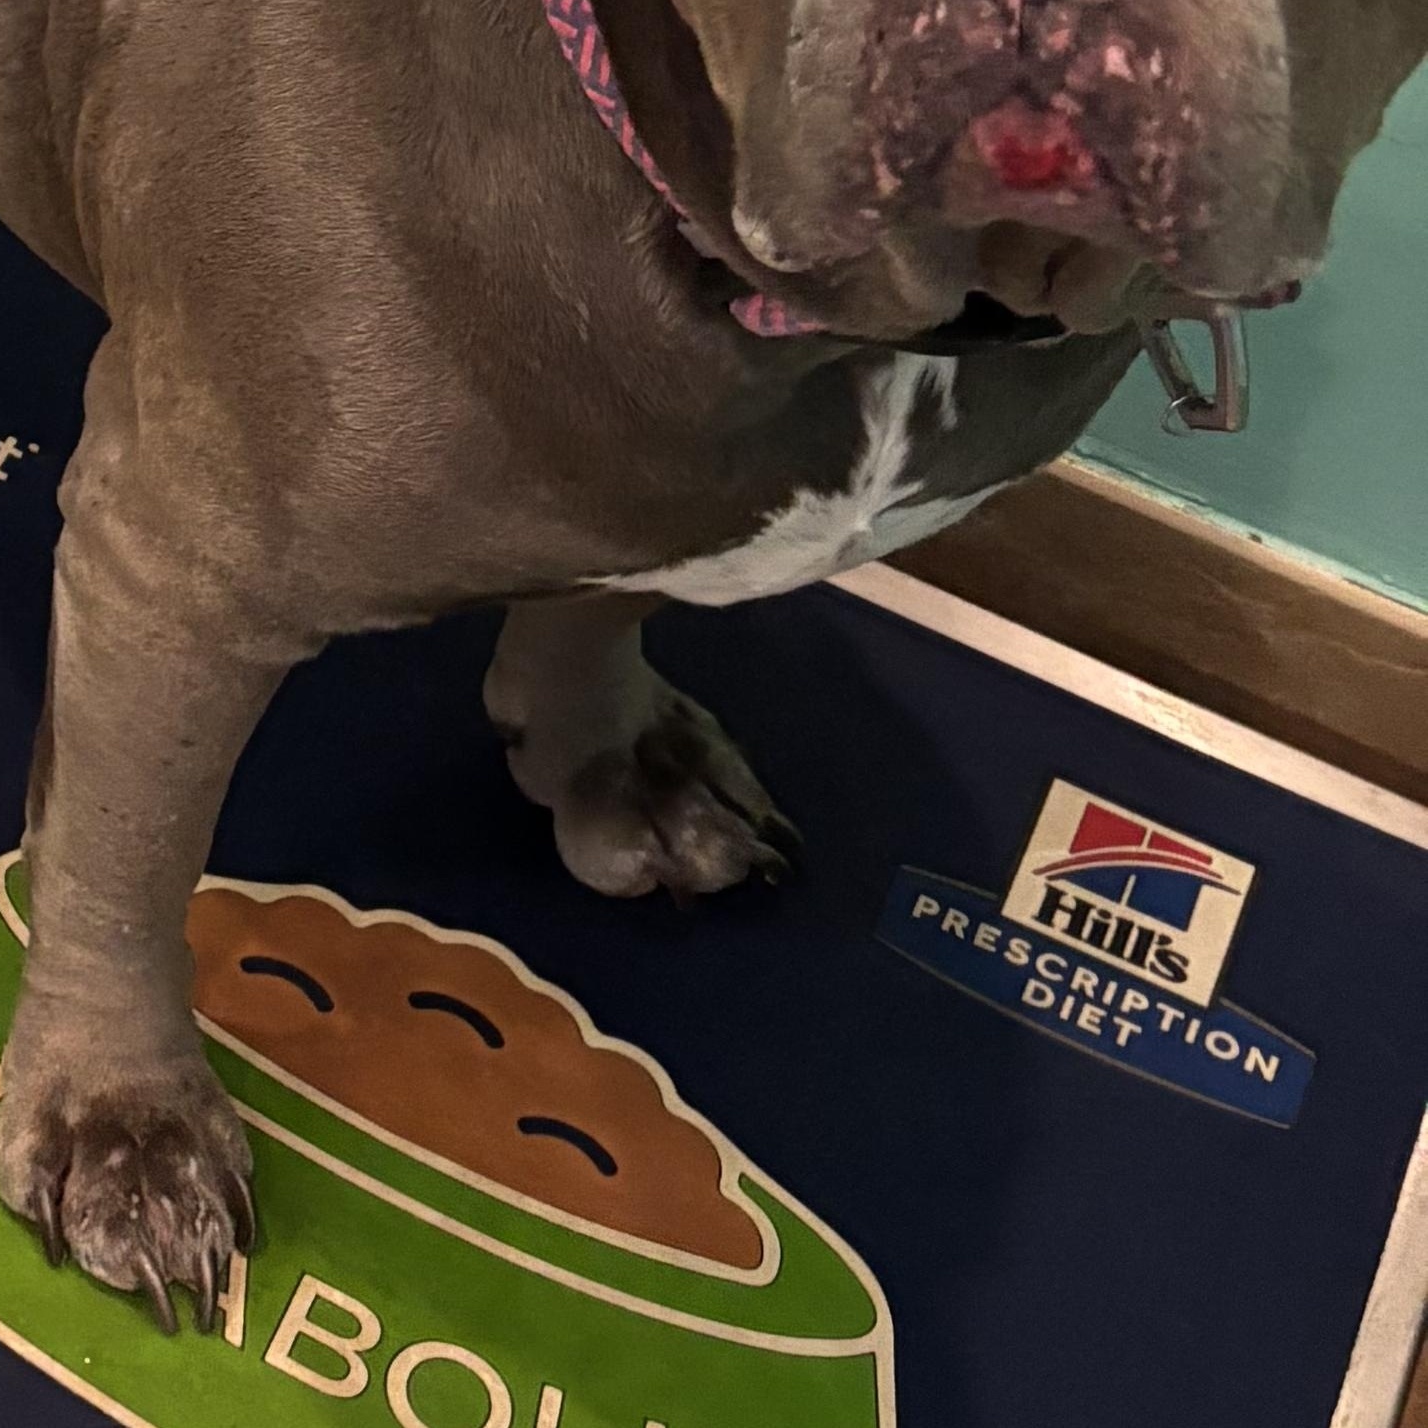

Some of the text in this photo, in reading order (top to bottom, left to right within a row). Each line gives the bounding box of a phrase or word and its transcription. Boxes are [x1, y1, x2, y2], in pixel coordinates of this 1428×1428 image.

[1030, 881, 1190, 985] Hill's
[911, 894, 1281, 1083] PRESCRIPTION
[1020, 978, 1144, 1049] DIET
